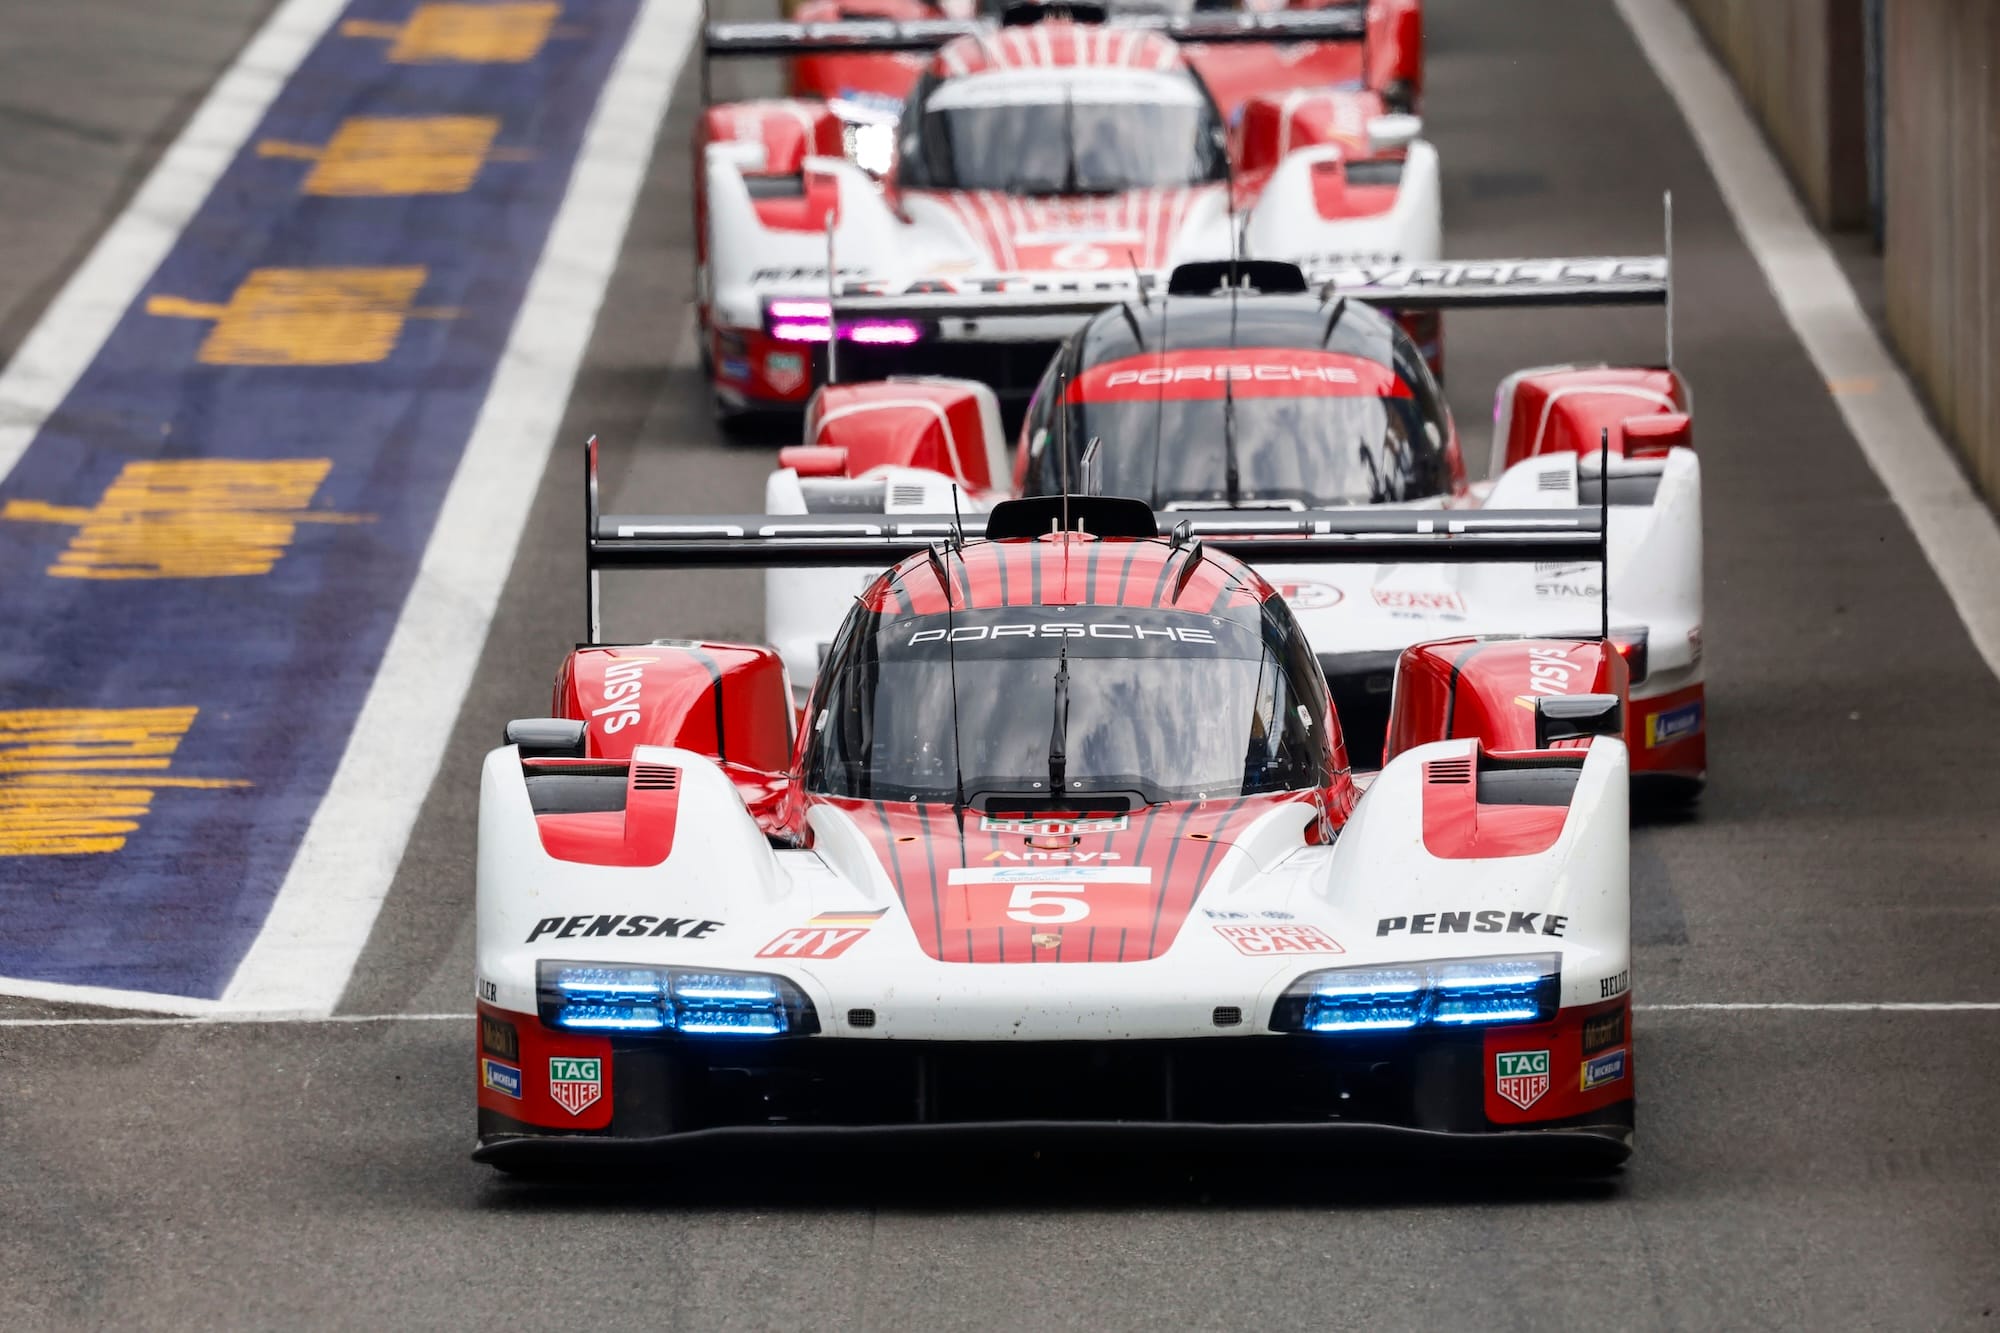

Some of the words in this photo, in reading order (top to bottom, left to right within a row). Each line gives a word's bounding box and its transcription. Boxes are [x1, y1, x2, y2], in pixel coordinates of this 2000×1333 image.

[1052, 241, 1110, 271] 6
[1106, 364, 1359, 388] PORSCHE
[908, 623, 1217, 647] PORSCHE
[592, 656, 660, 735] Ansys
[983, 851, 1122, 862] Ansys
[1006, 884, 1091, 924] 5
[525, 914, 726, 944] PENSKE
[1222, 927, 1317, 937] HYPER
[1375, 910, 1569, 938] PENSKE
[765, 929, 852, 956] HY
[1237, 936, 1335, 952] CAR
[553, 1062, 595, 1079] TAG
[1501, 1055, 1545, 1074] TAG
[493, 1071, 519, 1089] MICHELIN
[1500, 1077, 1547, 1105] HEUER
[553, 1083, 598, 1111] HEUER
